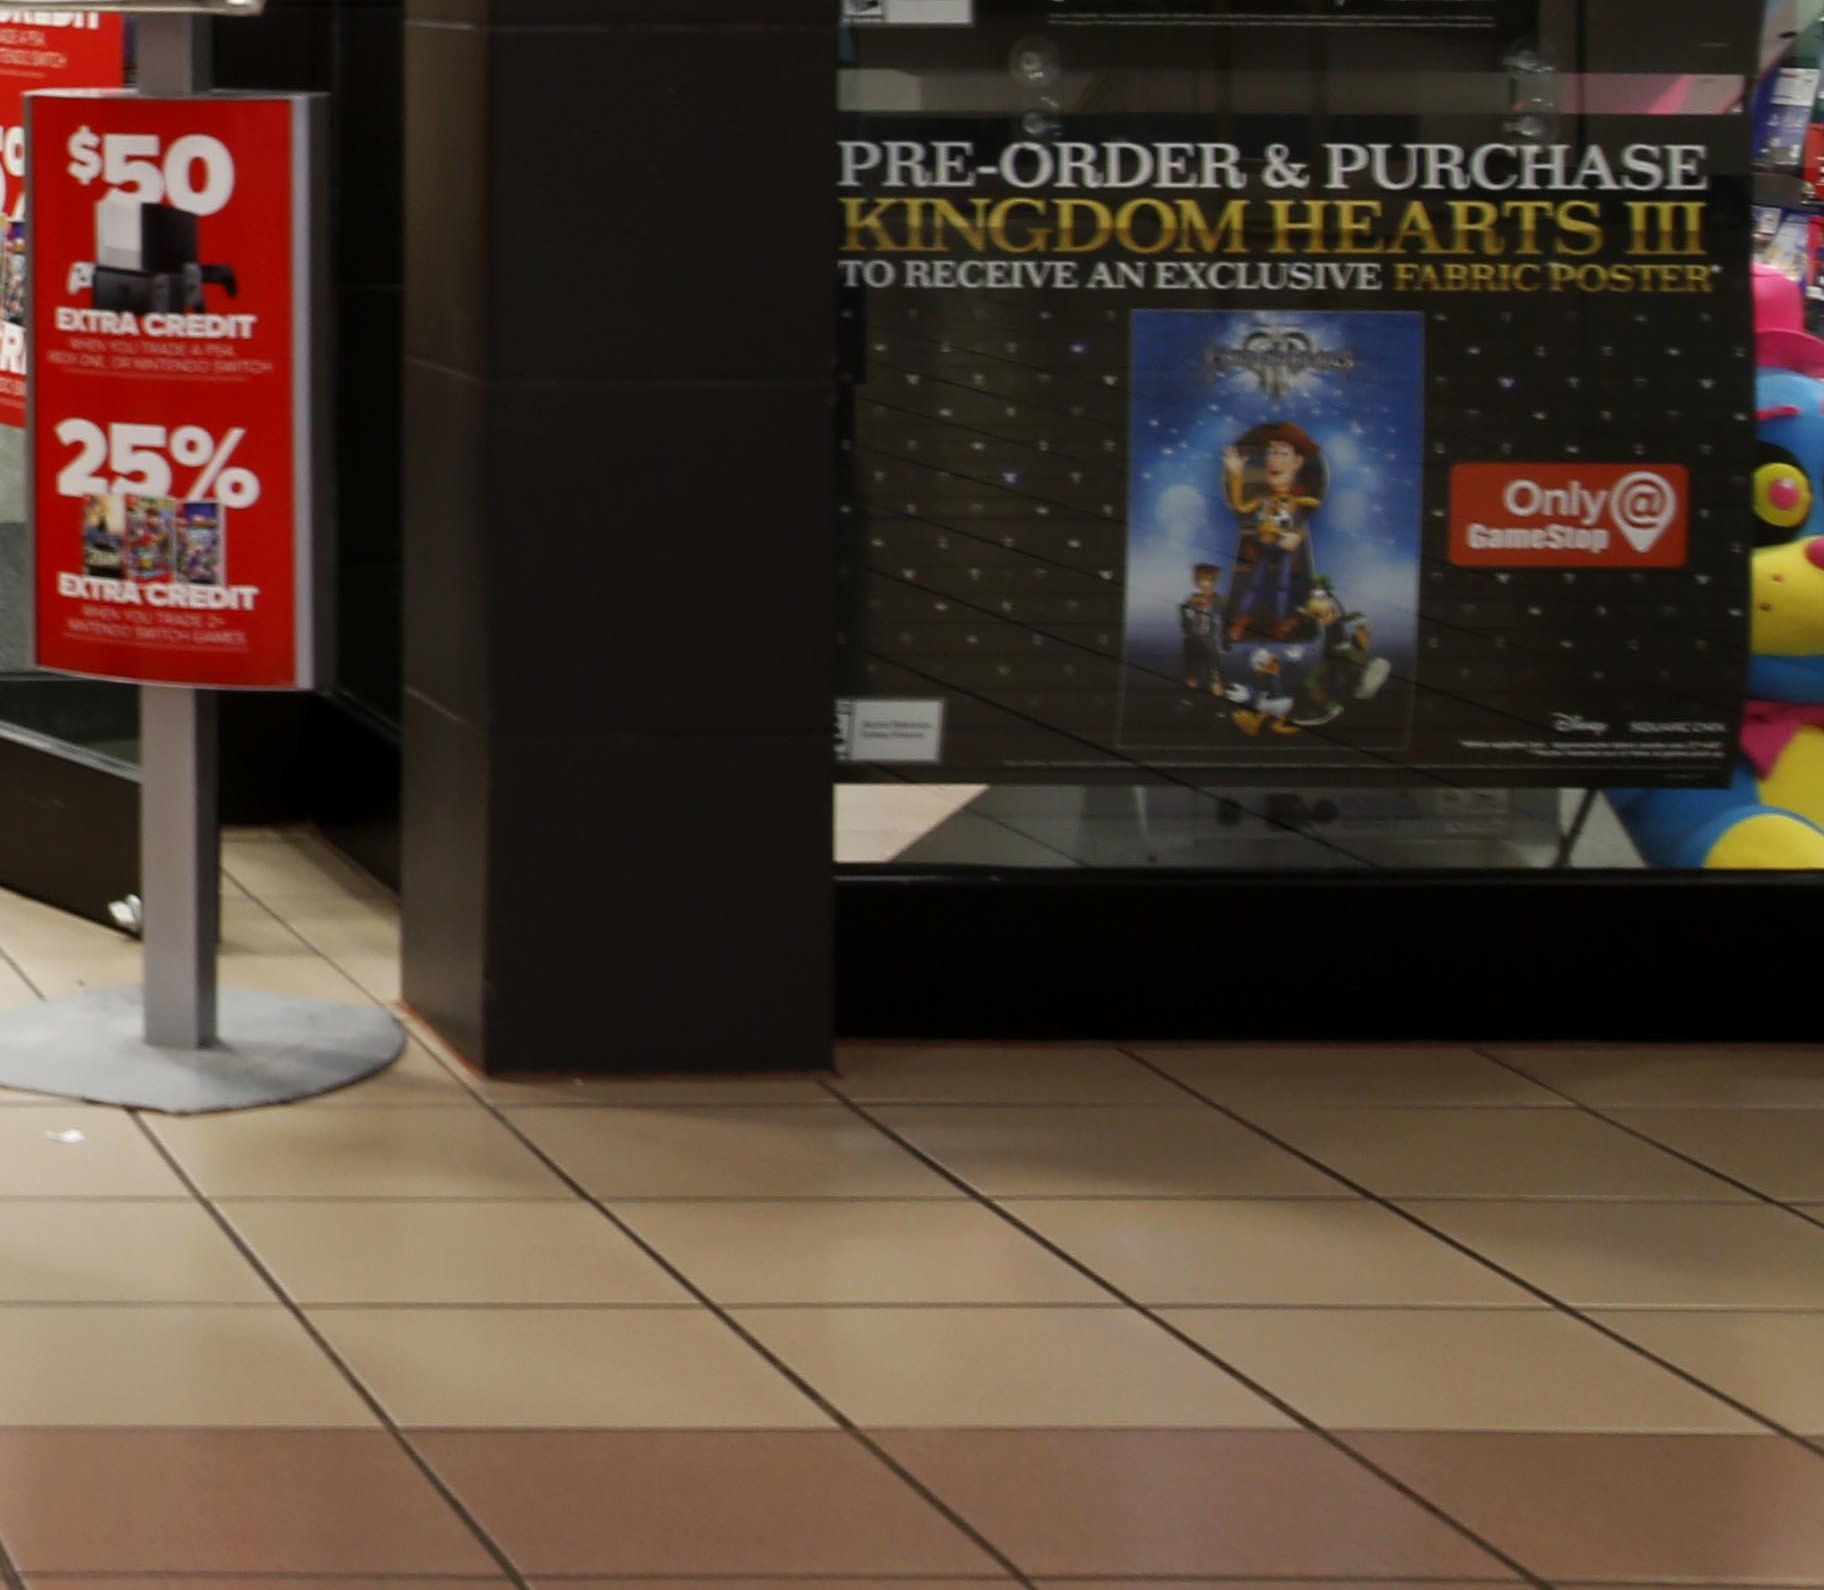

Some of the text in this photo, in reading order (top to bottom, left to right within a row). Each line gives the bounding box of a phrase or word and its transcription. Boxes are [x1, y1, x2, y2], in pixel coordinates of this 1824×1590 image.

[66, 125, 236, 217] $50
[837, 141, 1708, 192] PRE-ORDER & PURCHASE
[839, 198, 1708, 256] KINGDOM HEARTS III
[840, 260, 897, 290] TO
[904, 260, 1082, 291] RECEIVE
[1086, 260, 1151, 291] AN
[1154, 260, 1383, 293] EXCLUSIVE
[1392, 261, 1541, 294] FABRIC
[55, 305, 258, 340] EXTRA CREDIT
[54, 417, 261, 509] 25%
[1504, 479, 1609, 525] Only
[1466, 522, 1610, 554] GameStop
[57, 570, 261, 611] EXTRA CREDIT
